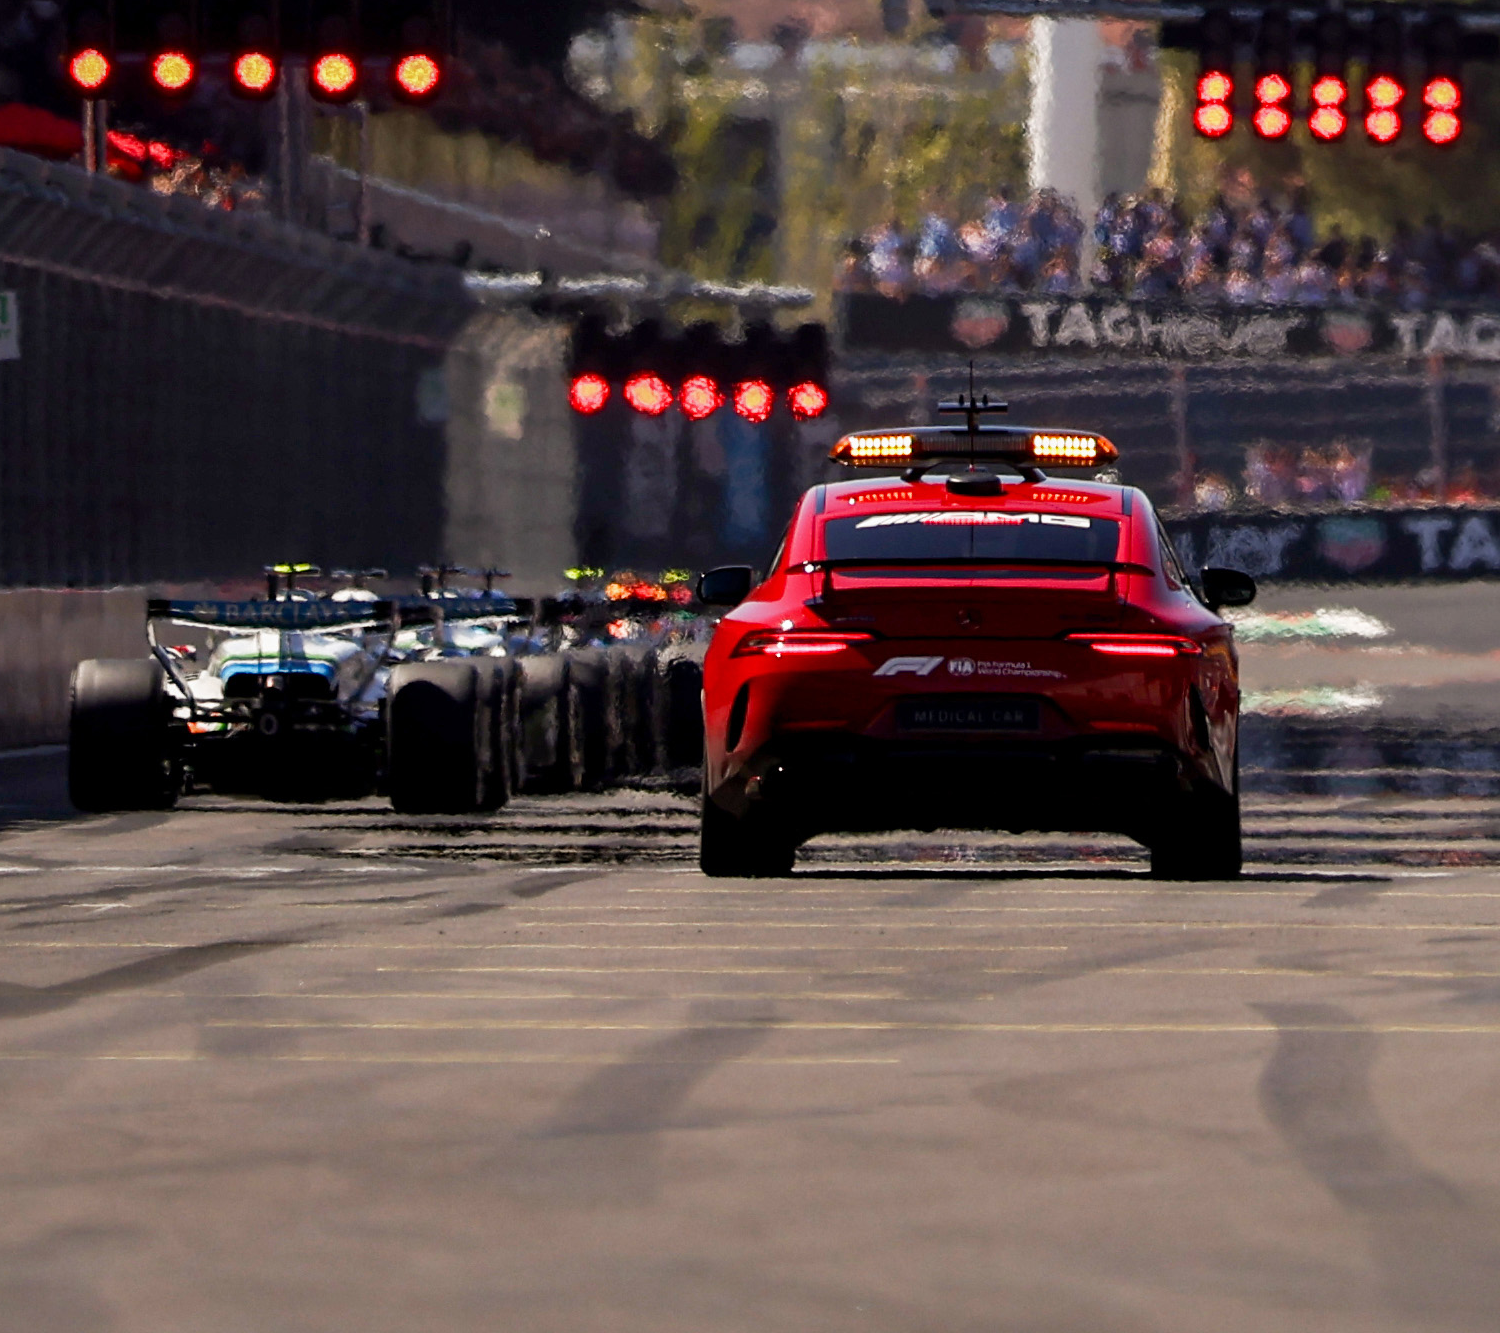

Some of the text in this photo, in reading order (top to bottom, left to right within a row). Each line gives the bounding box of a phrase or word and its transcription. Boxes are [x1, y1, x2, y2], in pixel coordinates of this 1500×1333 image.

[949, 660, 973, 674] FIA
[914, 709, 1025, 723] MEDICAL CAR
